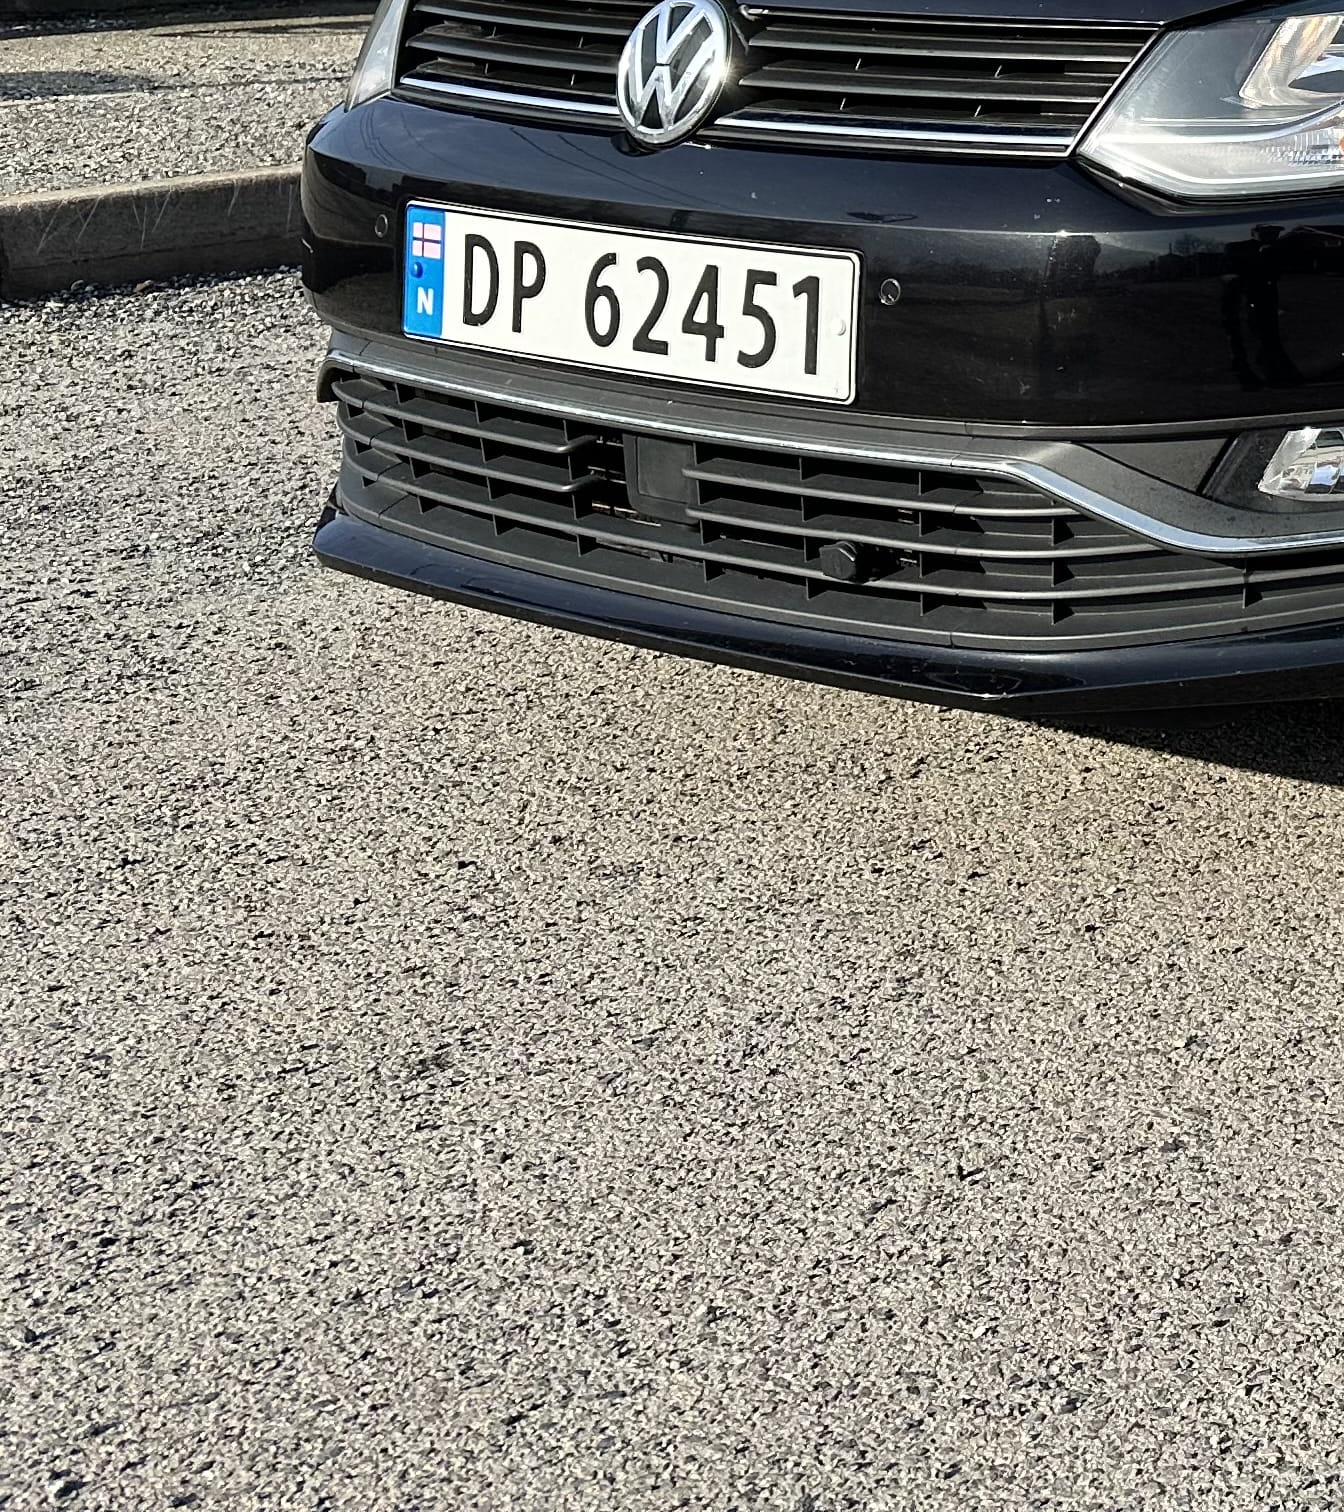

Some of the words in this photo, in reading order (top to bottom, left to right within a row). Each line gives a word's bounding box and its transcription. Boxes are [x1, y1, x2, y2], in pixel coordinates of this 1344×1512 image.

[417, 286, 434, 316] N
[463, 233, 546, 334] DP
[585, 252, 821, 376] 62451
